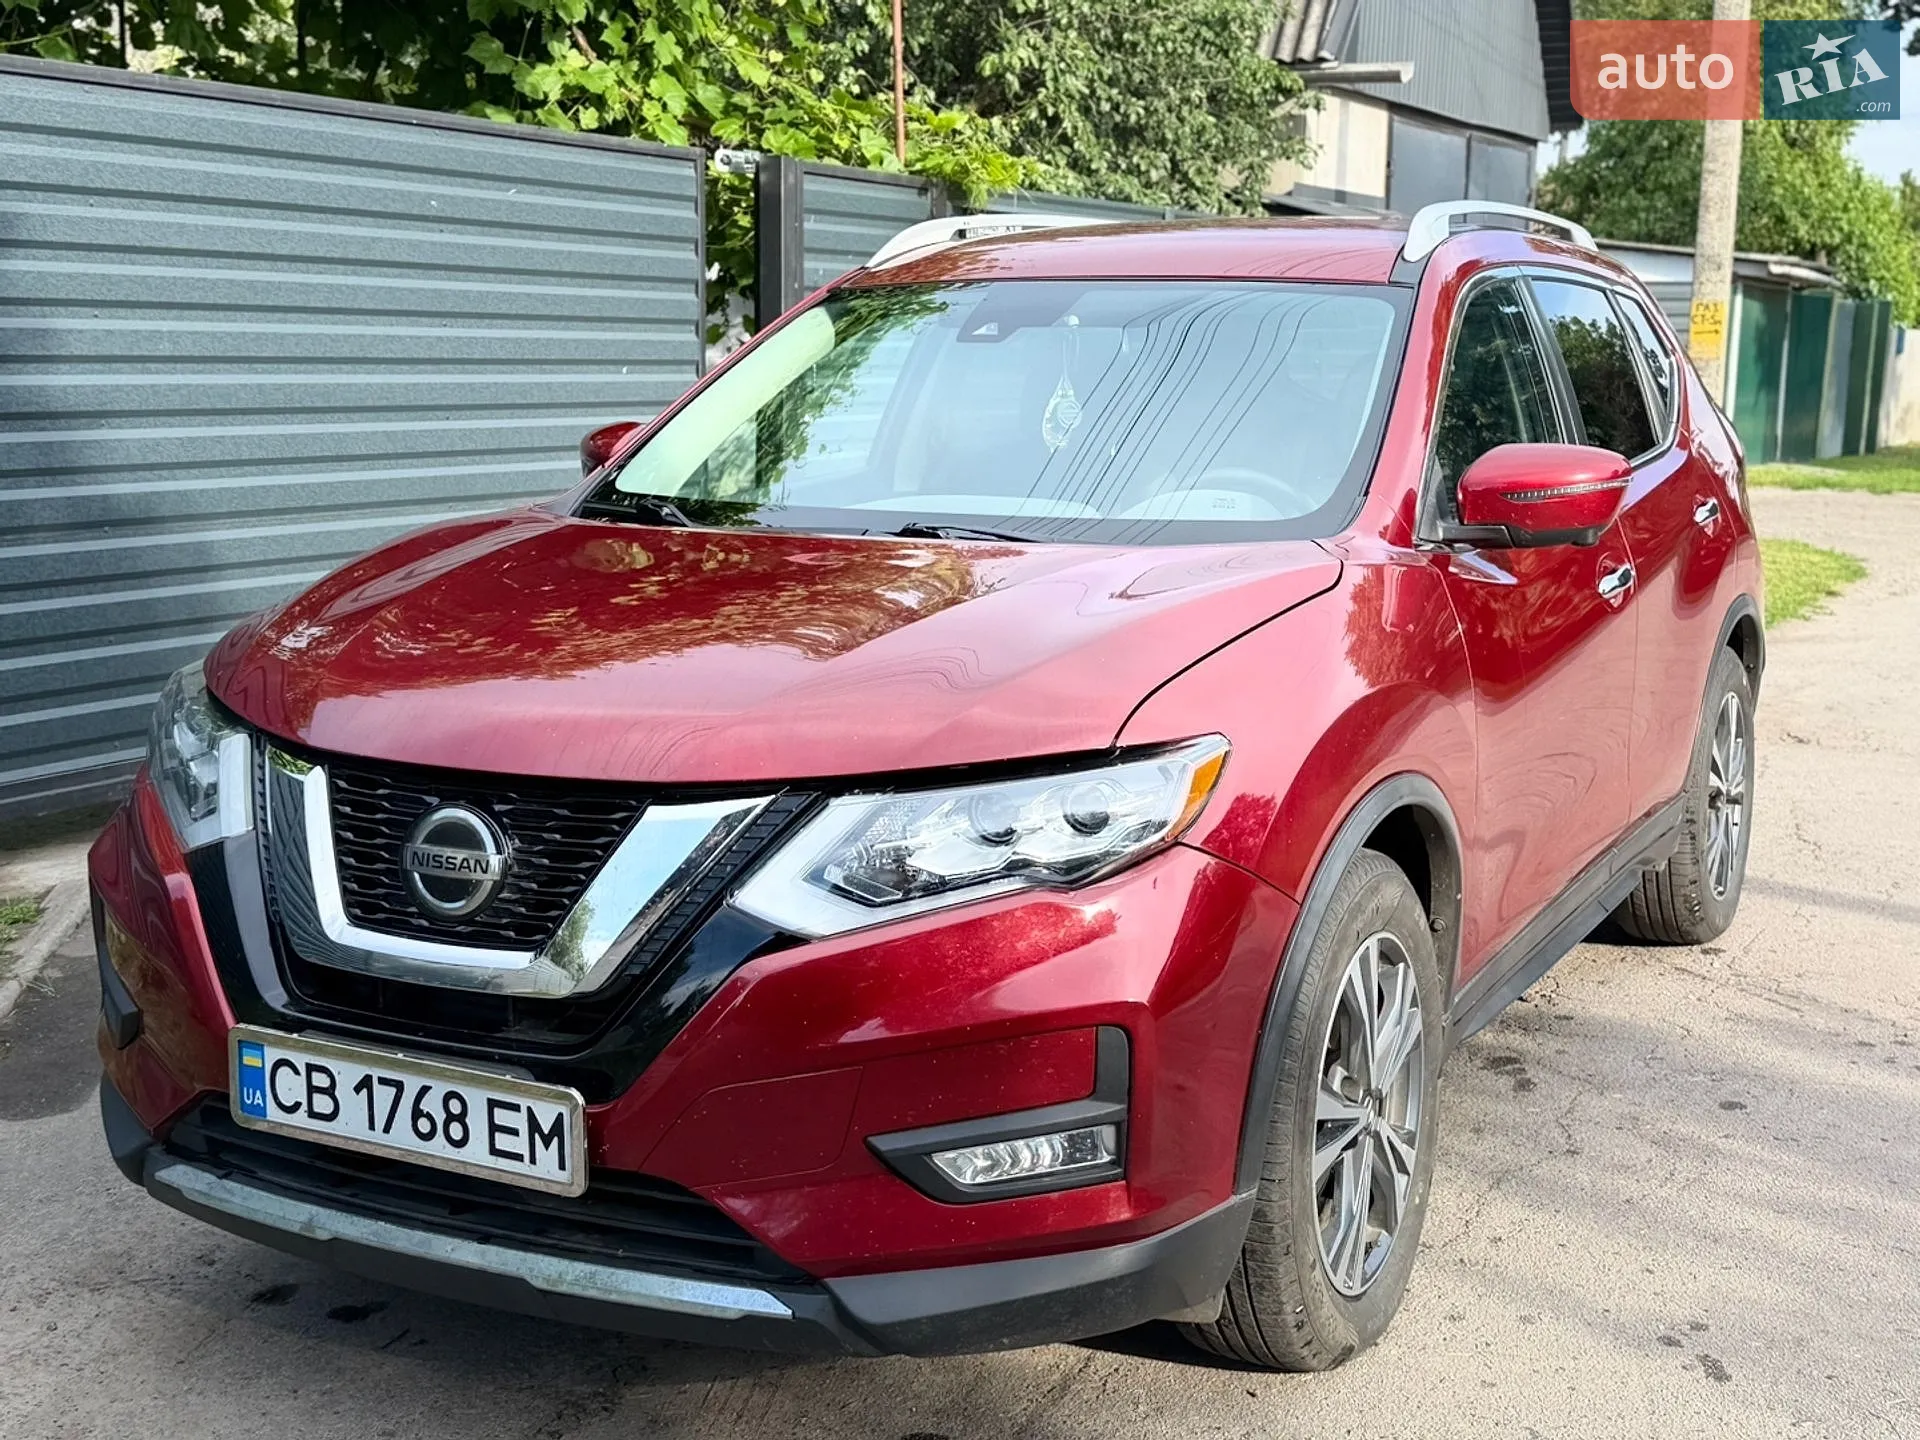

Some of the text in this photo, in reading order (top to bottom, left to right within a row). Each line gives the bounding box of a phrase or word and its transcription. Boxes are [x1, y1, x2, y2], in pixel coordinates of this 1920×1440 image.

[411, 851, 490, 875] NISSAN
[243, 1087, 265, 1108] UA
[269, 1057, 567, 1172] CB 1768 EM
